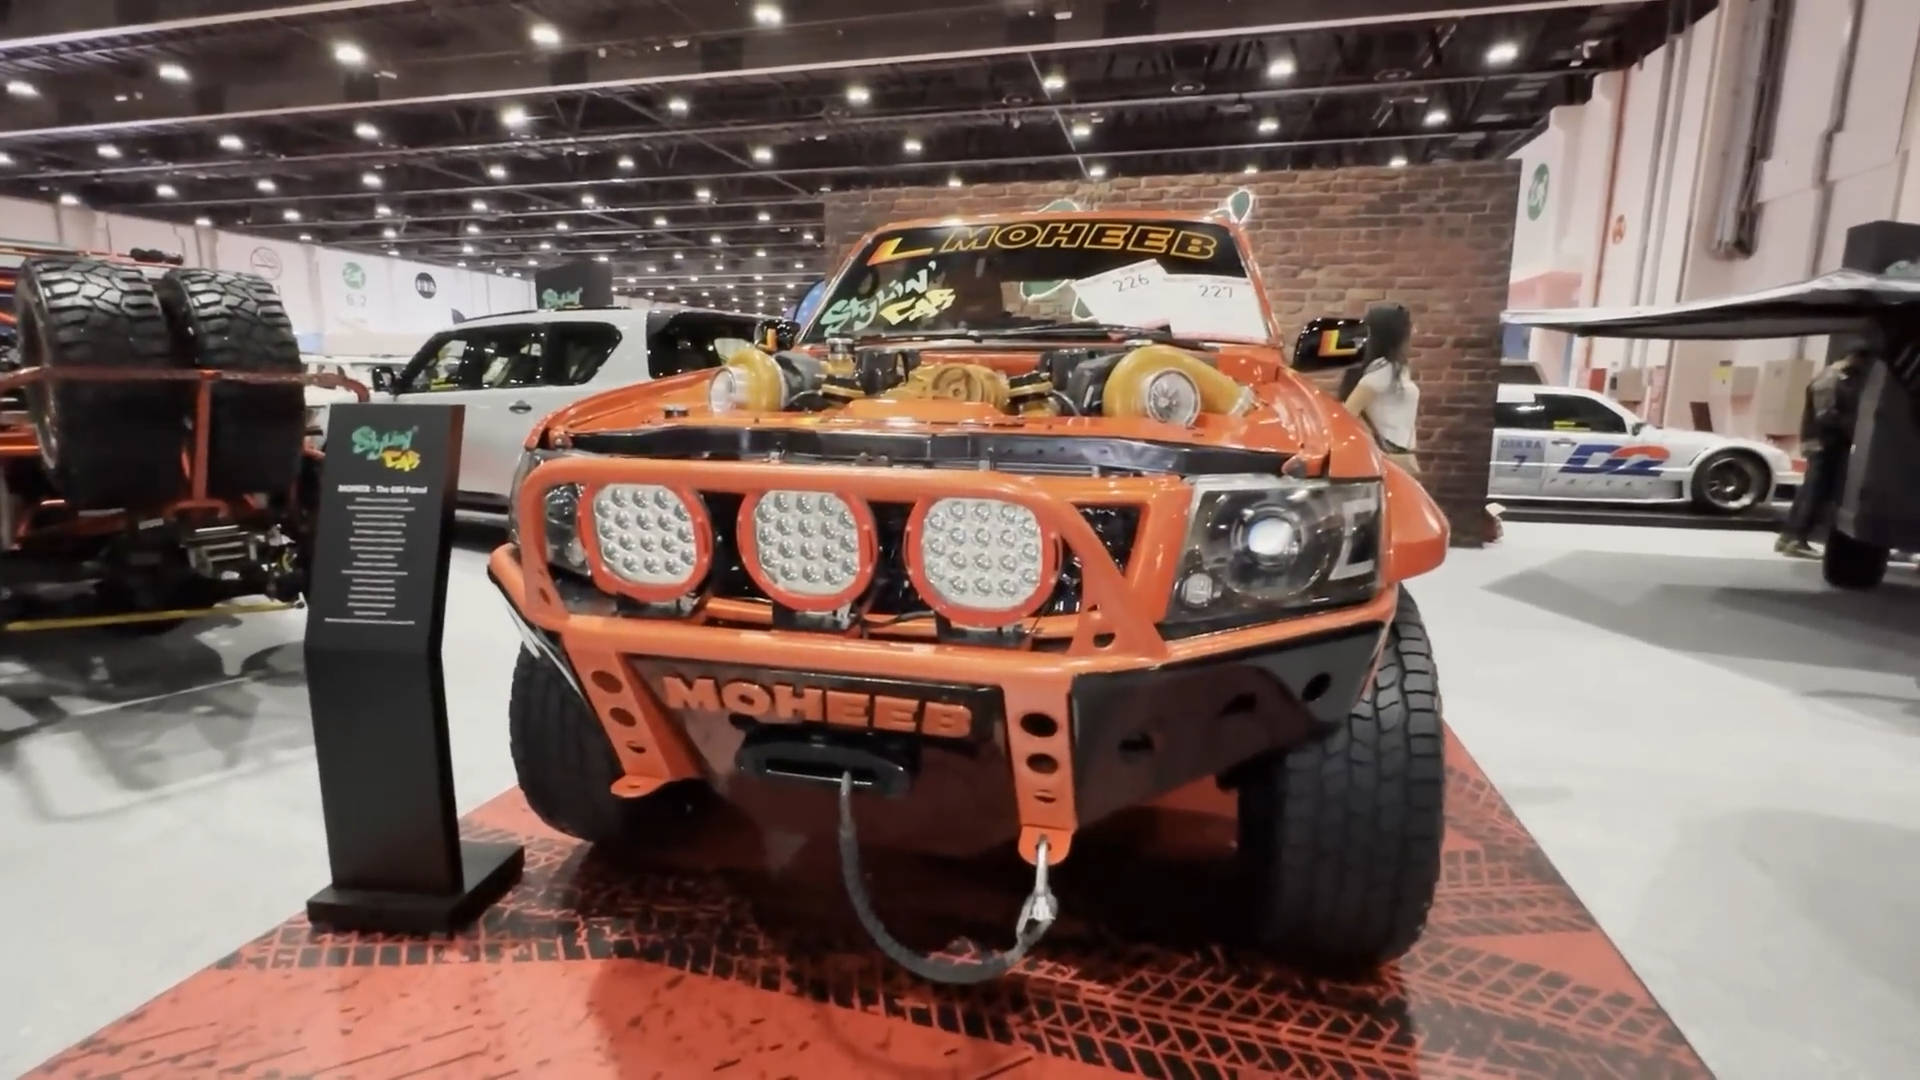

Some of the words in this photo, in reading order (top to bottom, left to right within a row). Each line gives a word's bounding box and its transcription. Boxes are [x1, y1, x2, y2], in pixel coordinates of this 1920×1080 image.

[939, 223, 1218, 260] MOHEEB
[1112, 274, 1150, 292] 226
[1198, 285, 1234, 299] 227
[1501, 438, 1542, 450] DEKRA
[1558, 443, 1671, 478] D2
[662, 676, 973, 738] MOHEEB
